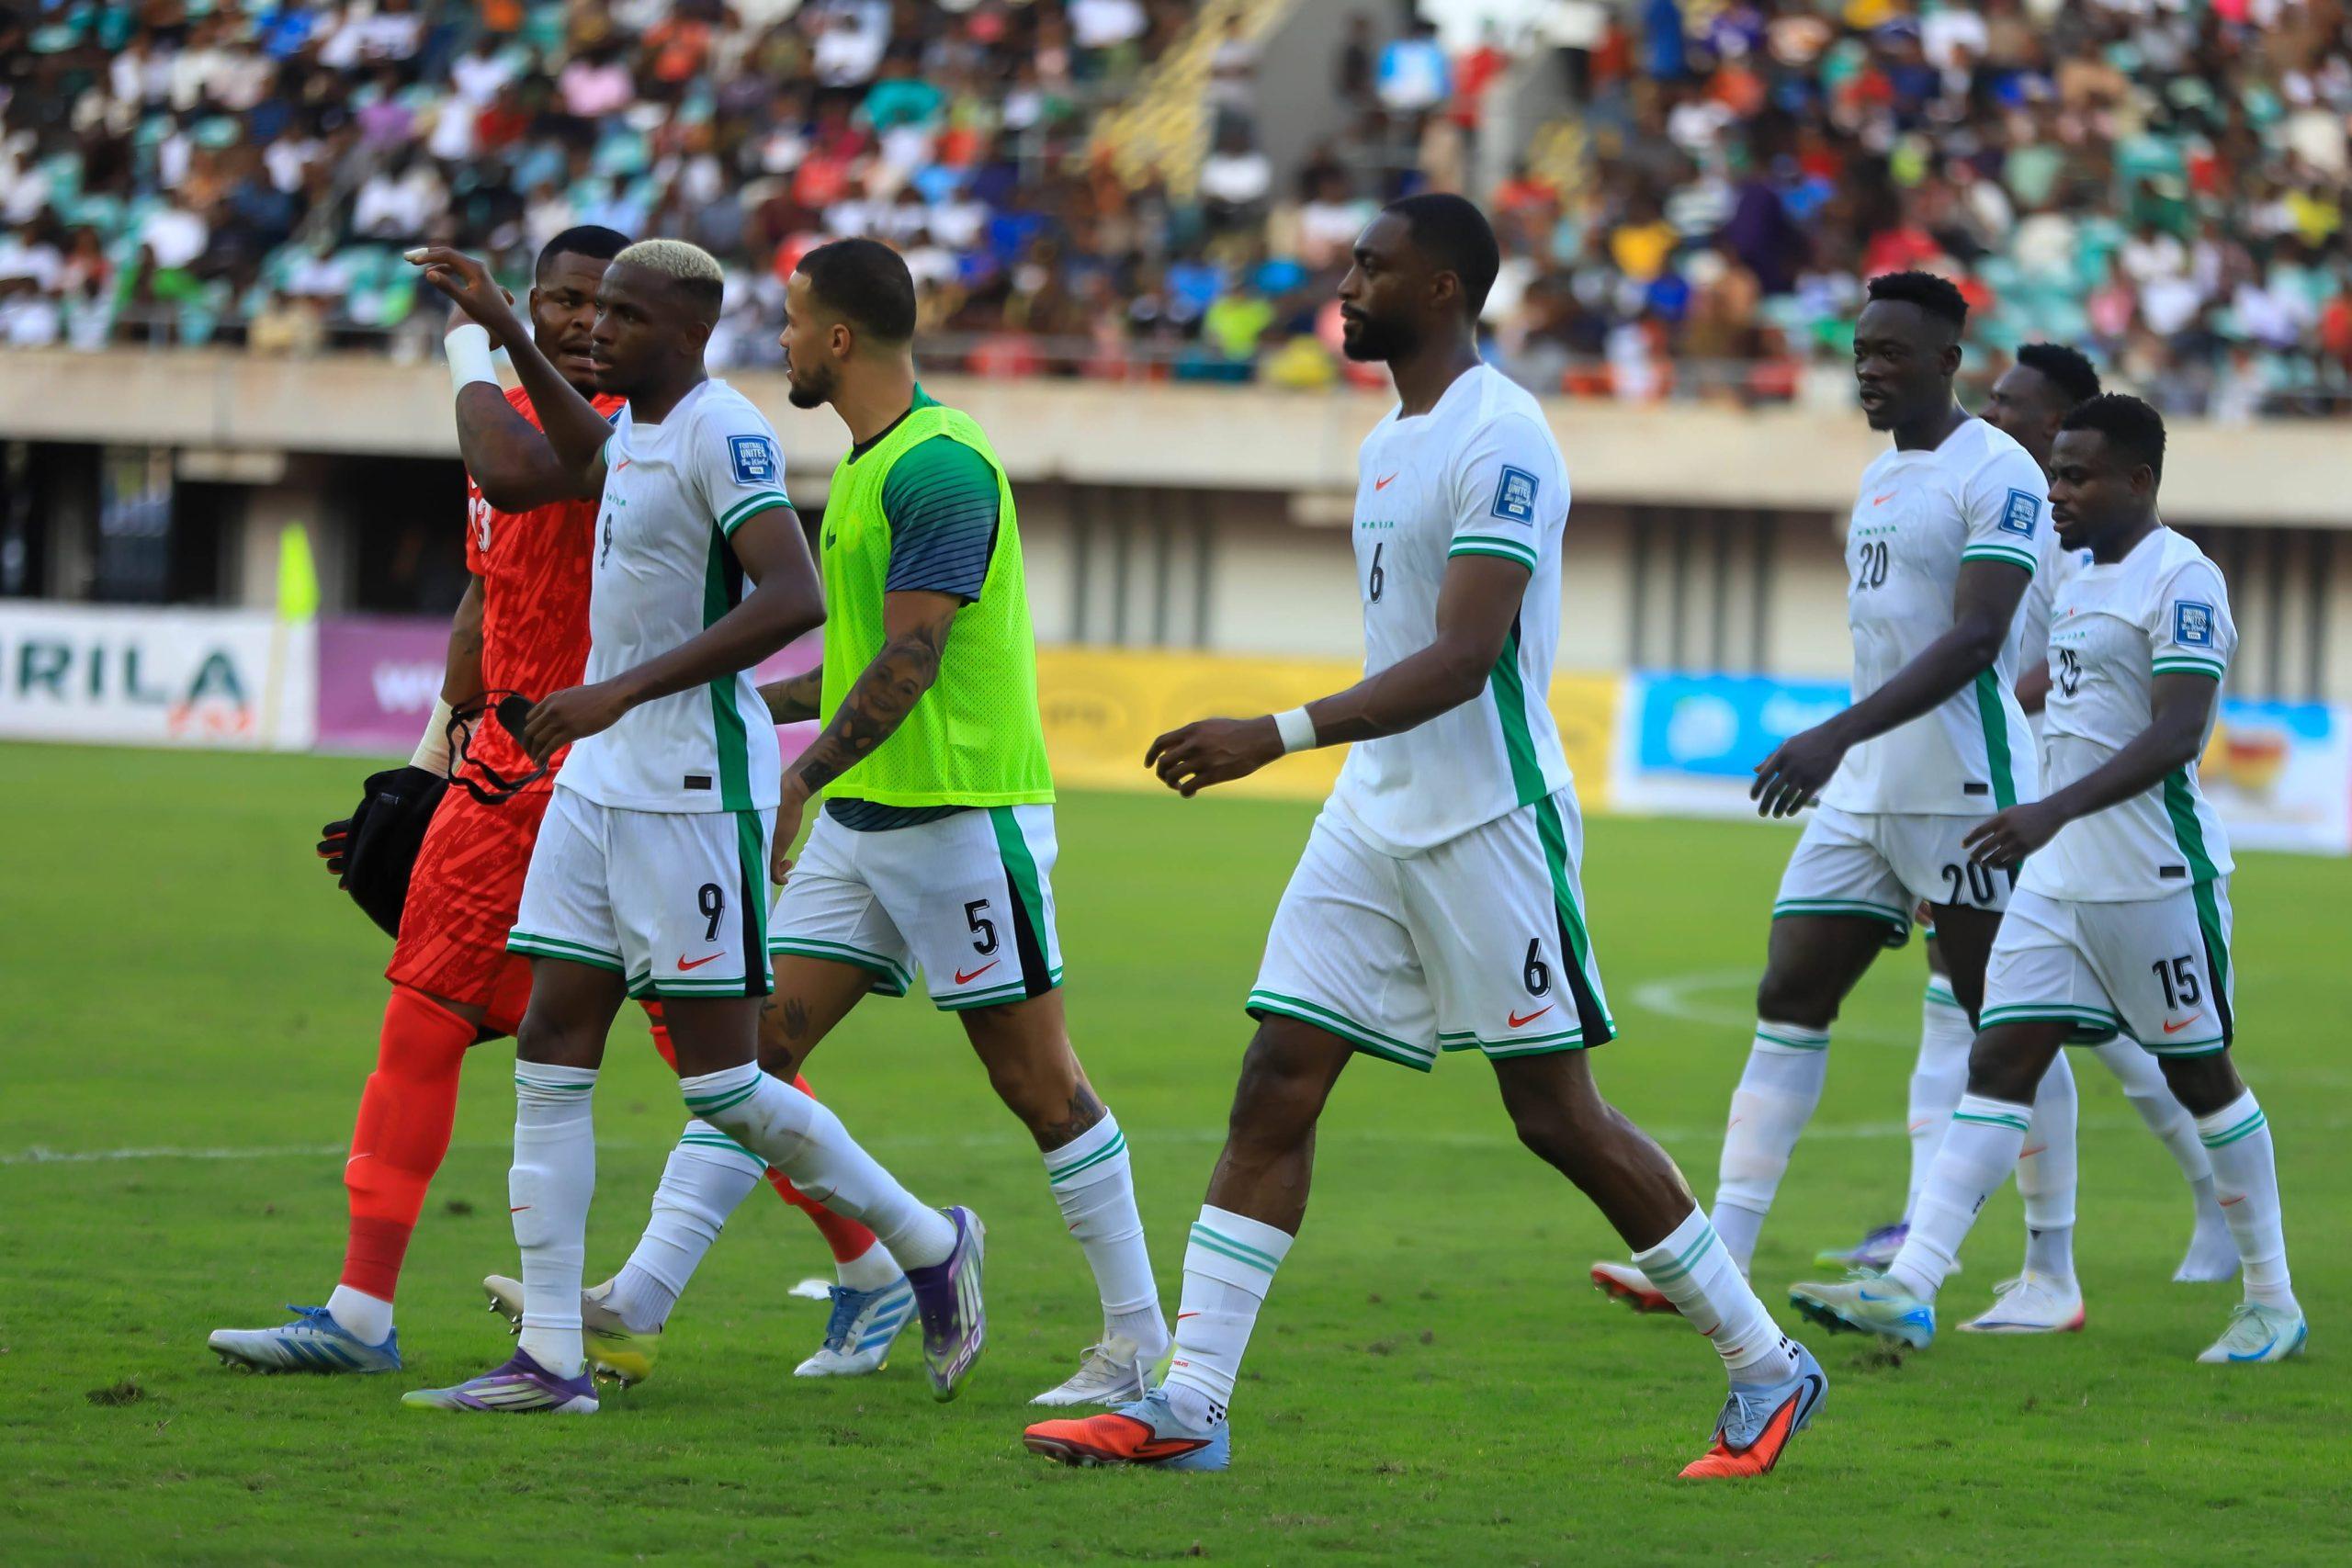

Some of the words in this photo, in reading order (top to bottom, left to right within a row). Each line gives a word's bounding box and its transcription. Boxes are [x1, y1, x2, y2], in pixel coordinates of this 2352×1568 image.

[740, 449, 767, 458] UNITES
[1369, 542, 1384, 604] 6
[1856, 541, 1888, 592] 20
[0, 638, 247, 709] RILA
[698, 883, 725, 942] 9
[1941, 860, 1997, 908] 20
[964, 898, 999, 955] 5
[1523, 937, 1551, 998] 6
[2152, 954, 2202, 1011] 15
[947, 1324, 981, 1391] F50
